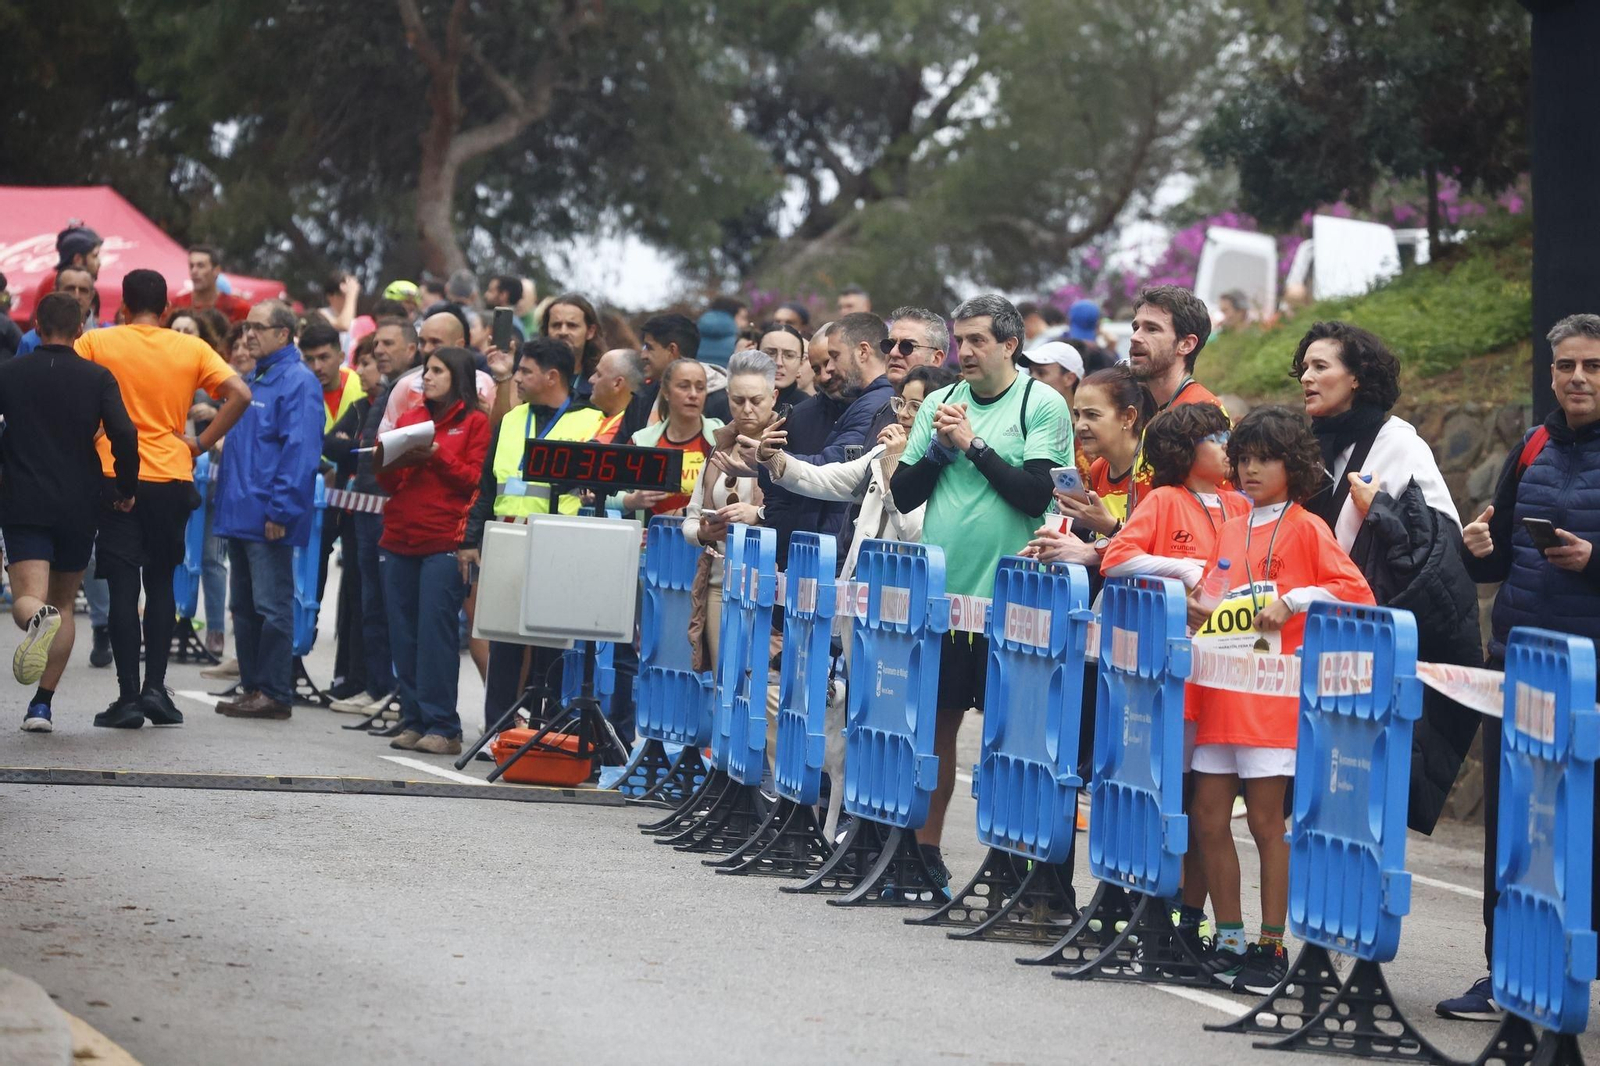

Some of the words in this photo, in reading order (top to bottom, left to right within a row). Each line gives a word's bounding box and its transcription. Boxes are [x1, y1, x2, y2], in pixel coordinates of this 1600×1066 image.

[577, 449, 617, 482] 36
[626, 454, 668, 483] 47
[1202, 606, 1262, 634] 100
